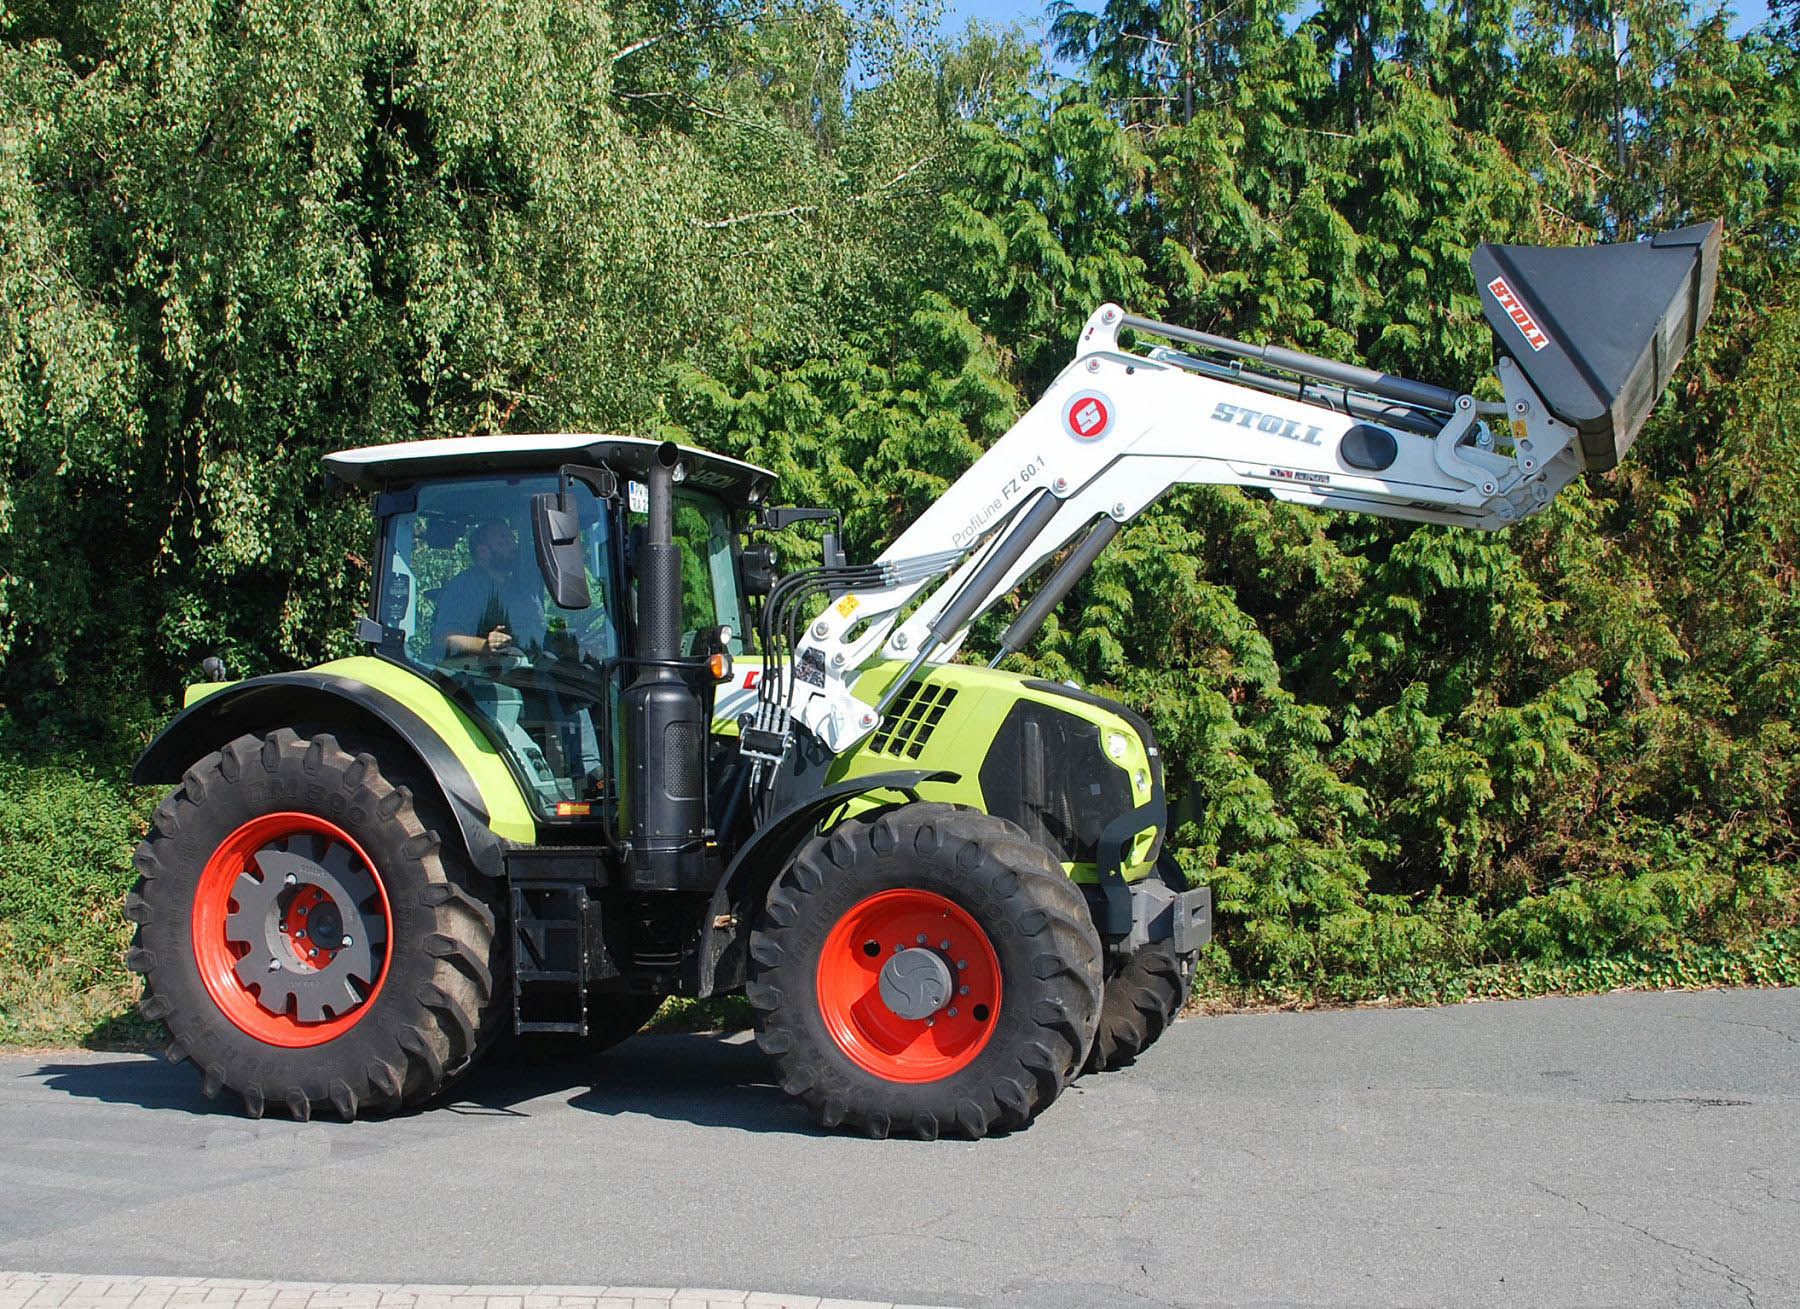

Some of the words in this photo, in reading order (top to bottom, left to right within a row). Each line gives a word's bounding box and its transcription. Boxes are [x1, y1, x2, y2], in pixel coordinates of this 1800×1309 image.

[1489, 277, 1546, 350] STOLL
[1210, 402, 1323, 447] STOLL
[951, 498, 1003, 548] ProfiLine
[1001, 478, 1022, 500] FZ
[1019, 455, 1046, 484] 60.1
